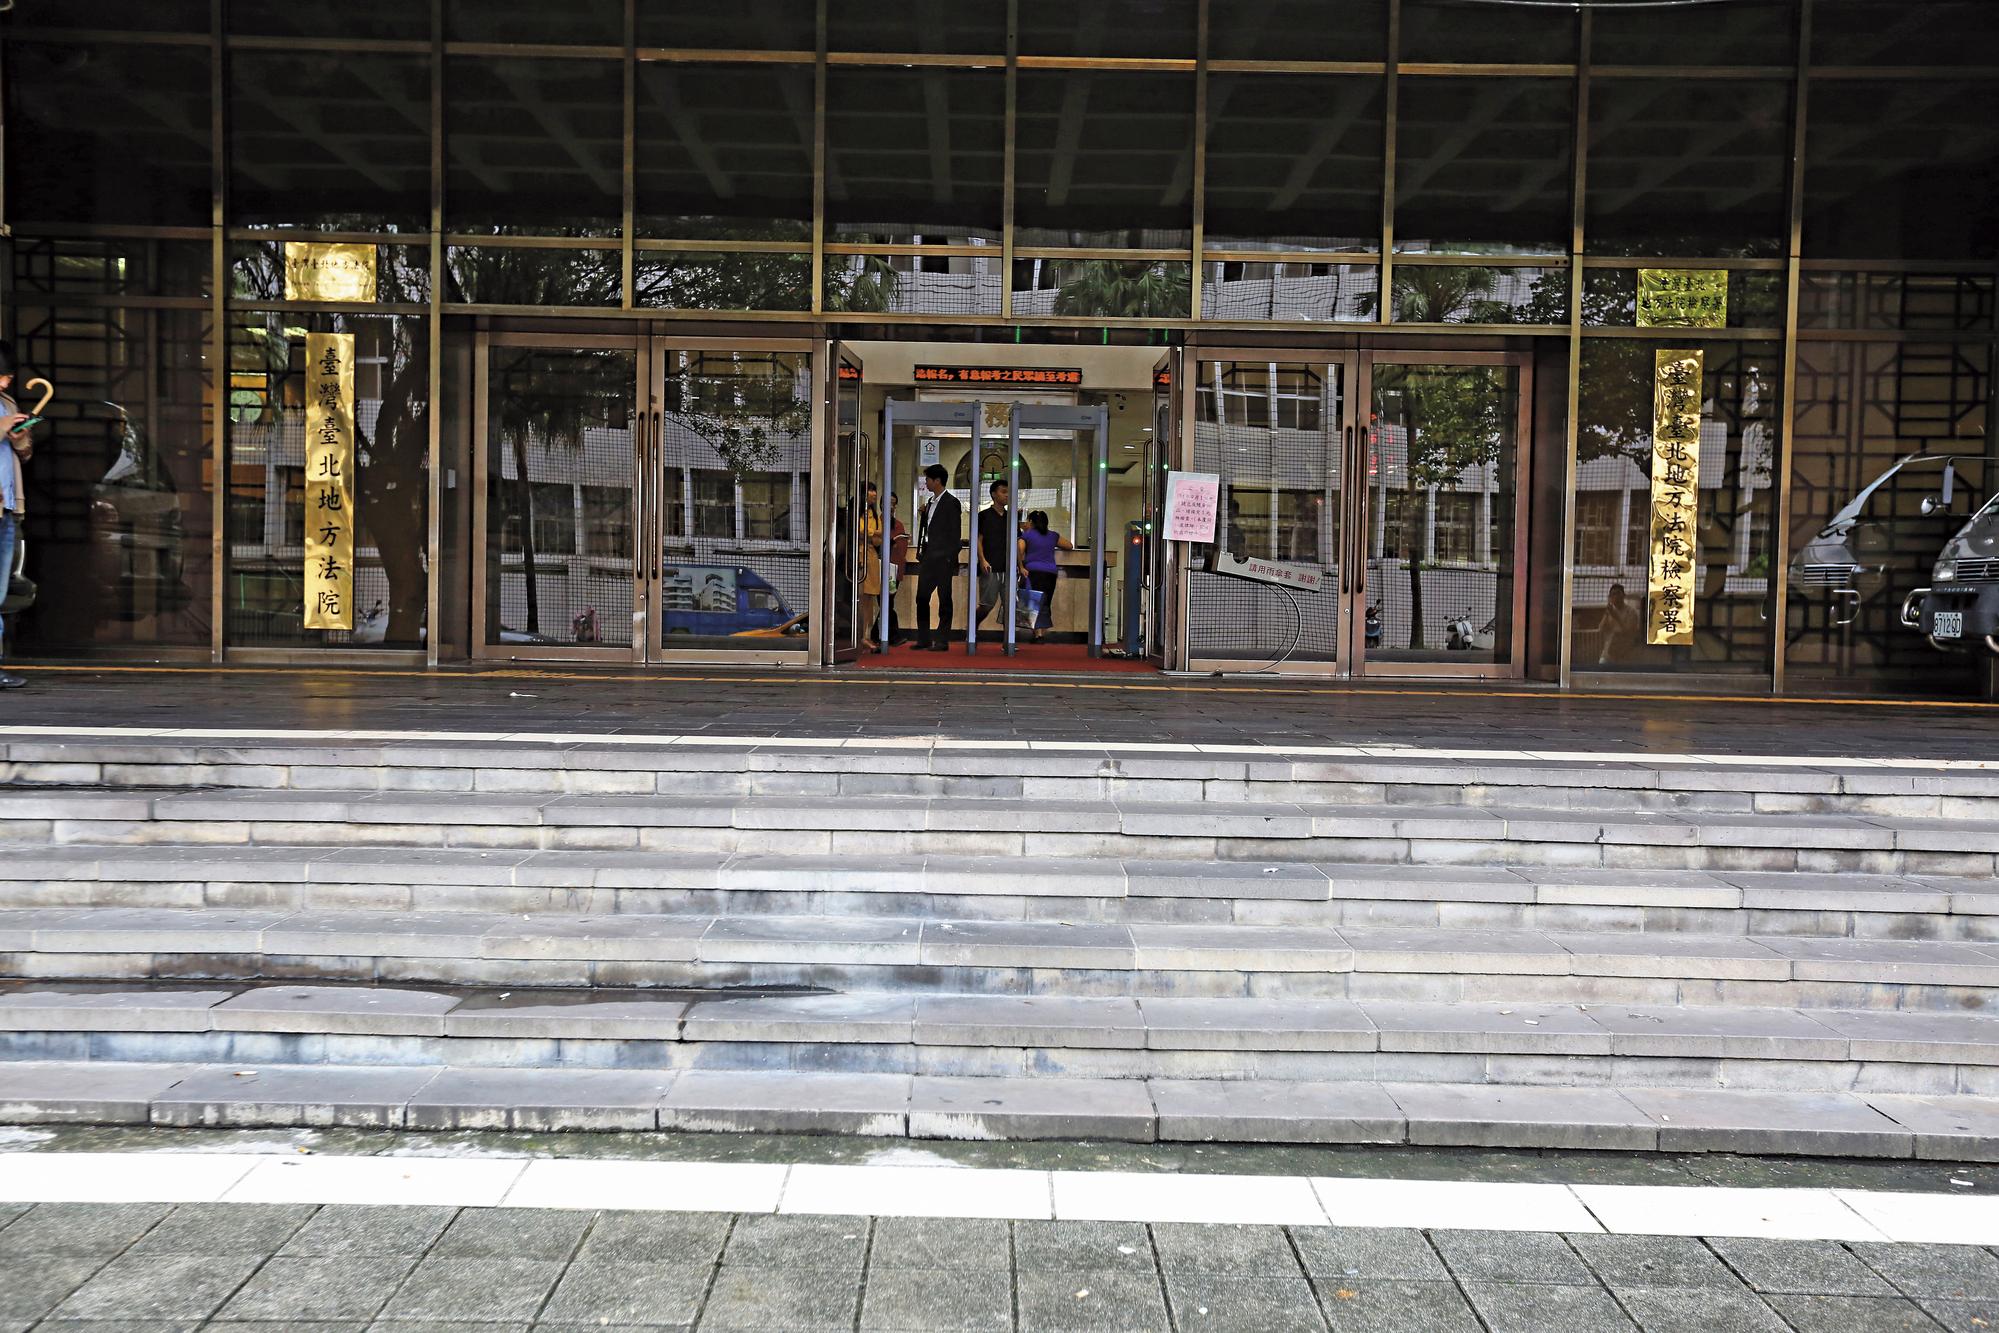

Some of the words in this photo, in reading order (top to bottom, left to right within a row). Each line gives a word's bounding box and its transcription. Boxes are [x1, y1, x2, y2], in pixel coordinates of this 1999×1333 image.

[317, 346, 342, 616] 臺灣臺北地方法院
[1658, 360, 1693, 634] 臺灣臺北地方法院檢察署
